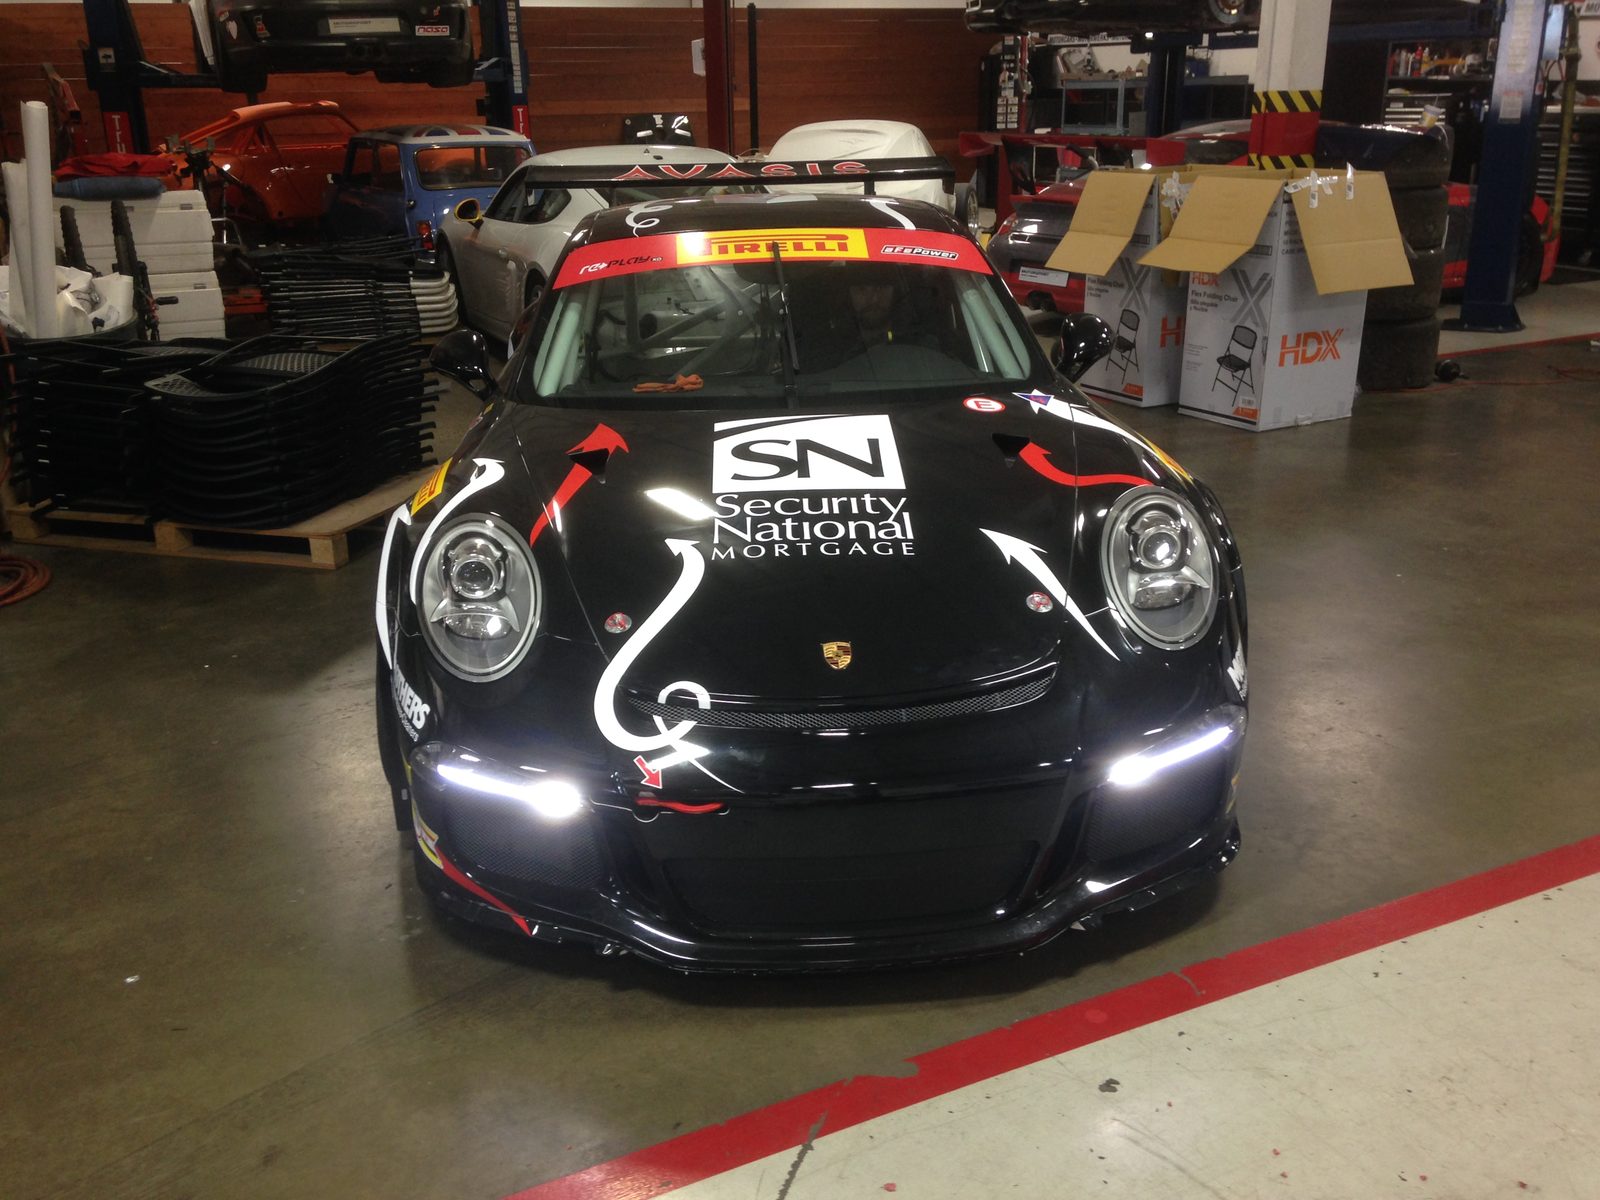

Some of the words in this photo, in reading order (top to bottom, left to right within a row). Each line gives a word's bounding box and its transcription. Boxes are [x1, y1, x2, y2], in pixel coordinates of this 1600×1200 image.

[611, 161, 871, 181] AVASIS
[1278, 328, 1344, 368] HDX
[730, 438, 885, 481] SN
[715, 493, 907, 524] Security
[713, 511, 915, 544] National
[711, 541, 915, 561] MORTGAGE
